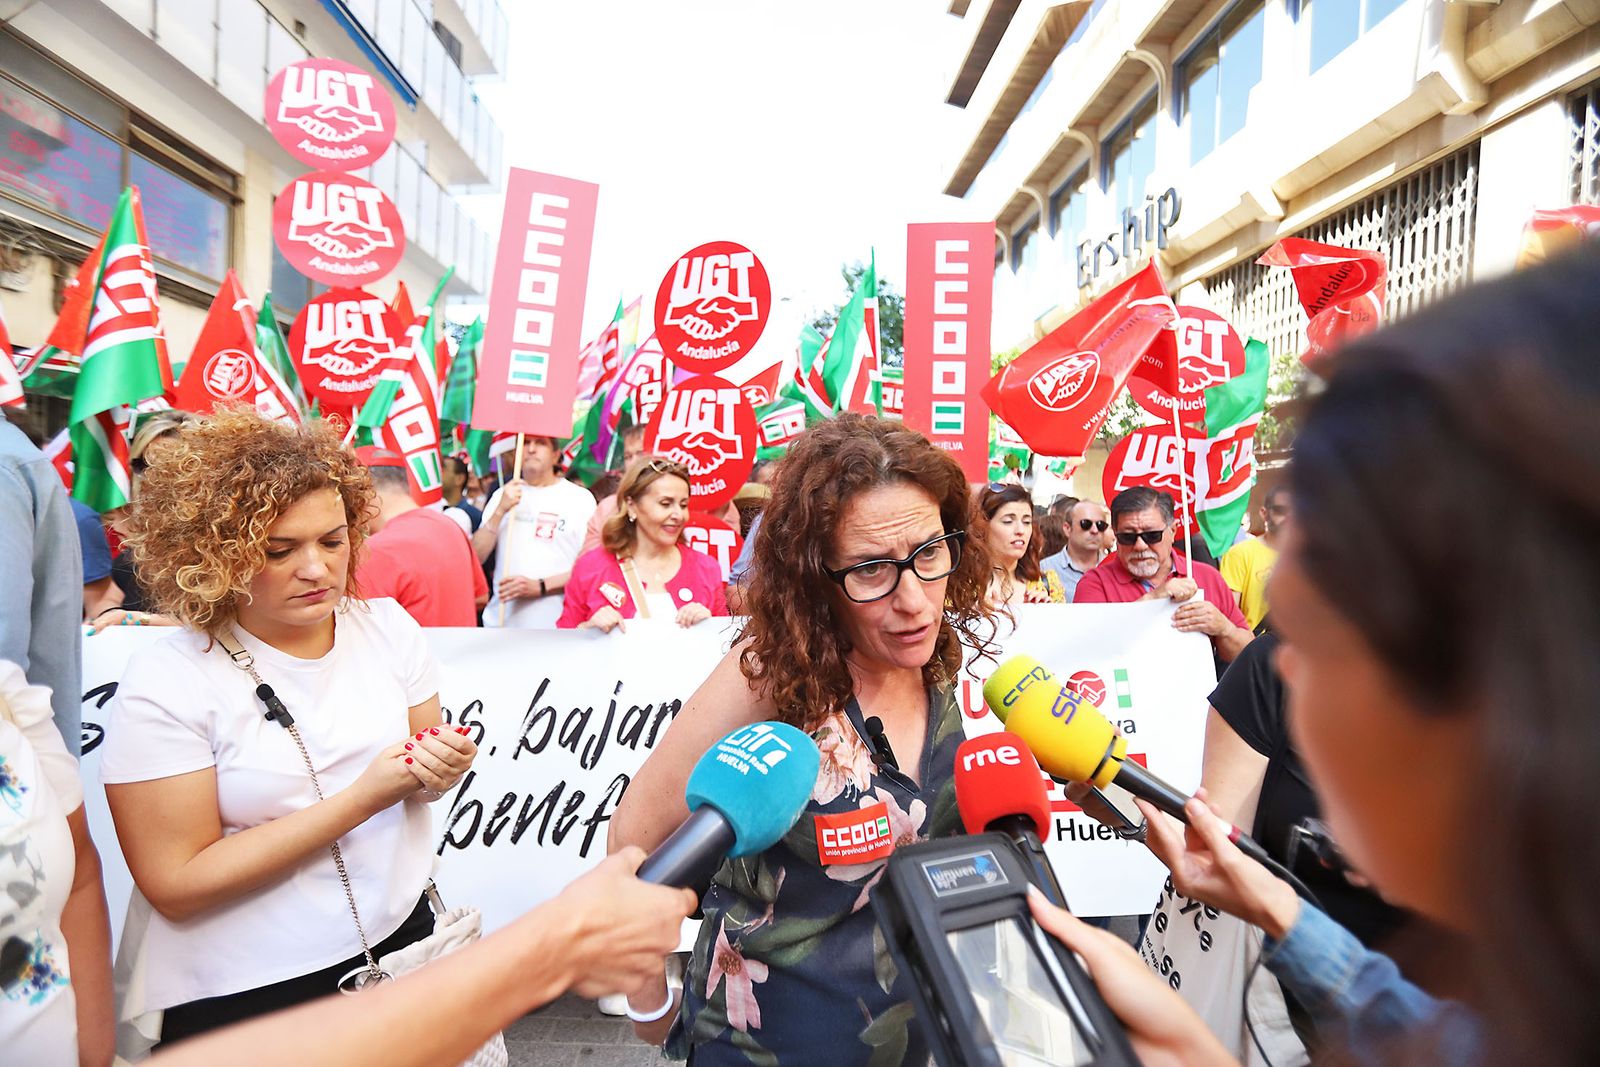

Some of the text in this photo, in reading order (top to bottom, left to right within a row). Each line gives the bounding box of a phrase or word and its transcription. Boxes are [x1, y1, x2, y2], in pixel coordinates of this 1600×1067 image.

[281, 66, 374, 112] UGT
[297, 139, 369, 159] Andalucía
[292, 181, 384, 228] UGT
[1077, 187, 1182, 289] Ership
[308, 256, 380, 275] Andalucía
[512, 192, 570, 347] CCOO
[670, 252, 755, 301] UGT
[305, 300, 387, 343] UGT
[932, 240, 969, 395] CCOO
[676, 340, 740, 360] Andalucía
[1178, 317, 1229, 363] GT
[319, 377, 380, 393] Andalucí
[1147, 390, 1207, 411] Andlucí
[658, 388, 741, 439] UGT
[690, 478, 727, 496] alucía
[682, 526, 736, 582] GT
[963, 746, 1021, 771] rne
[822, 820, 878, 848] CCOO
[825, 849, 841, 857] unión
[842, 845, 868, 857] provincial
[875, 838, 891, 848] Huelva
